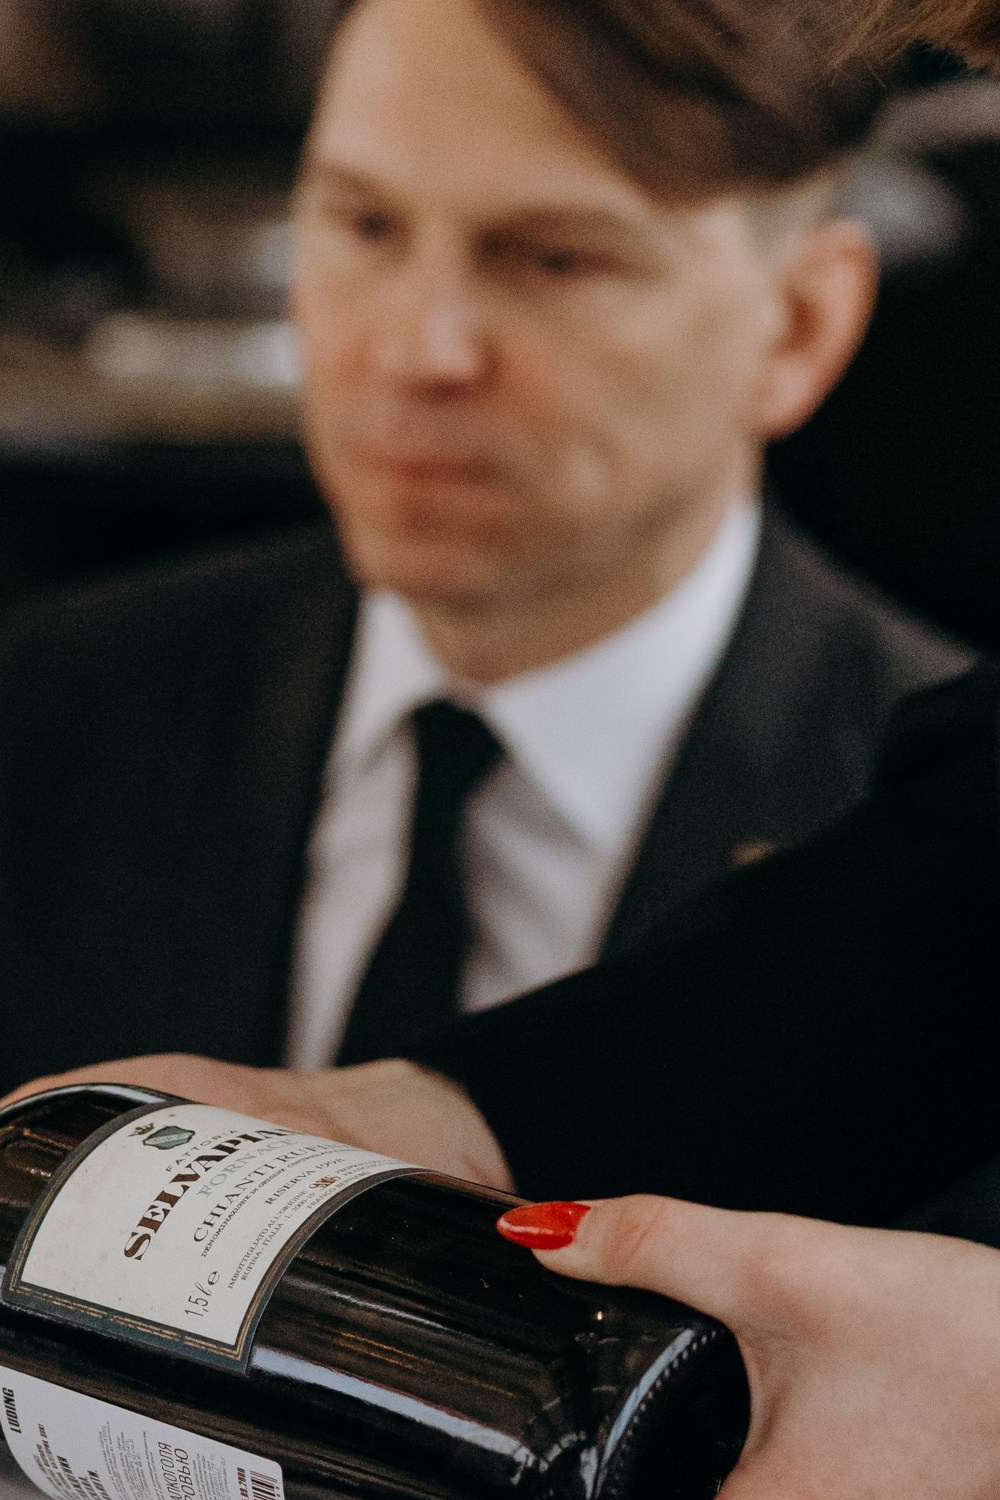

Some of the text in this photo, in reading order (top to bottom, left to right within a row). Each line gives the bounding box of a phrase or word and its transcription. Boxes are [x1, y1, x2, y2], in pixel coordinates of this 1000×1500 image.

[165, 1130, 239, 1172] FATTORIA
[193, 1162, 275, 1242] CHIANTI
[265, 1168, 316, 1205] RISERVA
[201, 1193, 252, 1258] DENOMINAZIONE
[262, 1221, 285, 1247] ITALIA
[227, 1227, 269, 1290] IMBOTTIGLIATO
[2, 1386, 22, 1434] LUDING
